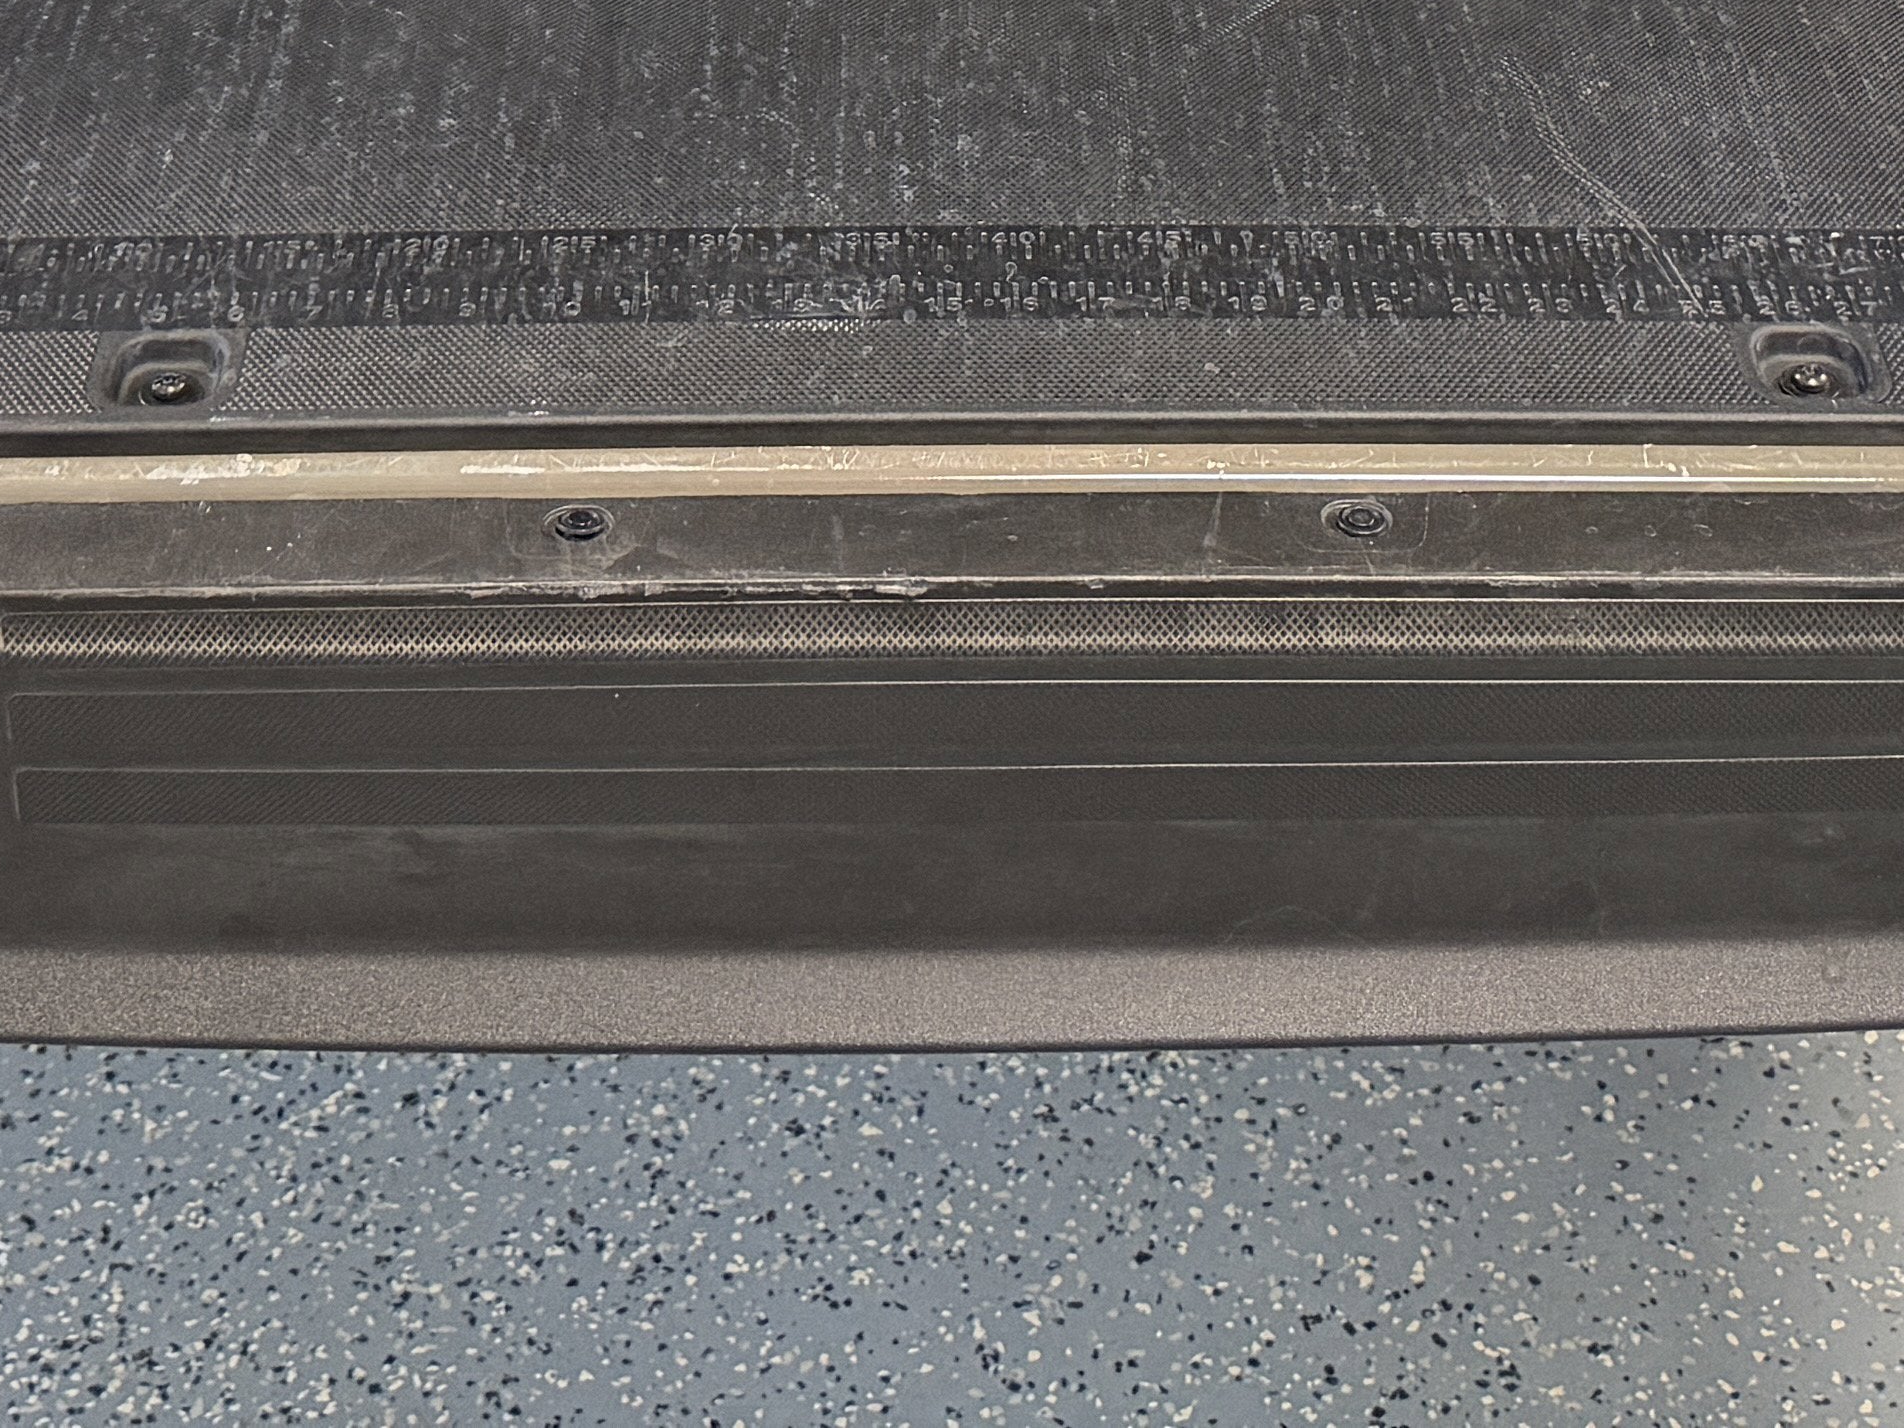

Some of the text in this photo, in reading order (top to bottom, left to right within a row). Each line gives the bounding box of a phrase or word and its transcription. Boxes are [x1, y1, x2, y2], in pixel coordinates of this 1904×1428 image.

[992, 231, 1036, 245] 40
[1137, 231, 1182, 244] 45
[1430, 232, 1475, 246] 55
[924, 297, 963, 312] 15
[1076, 297, 1116, 312] 17
[1298, 296, 1345, 312] 20
[1451, 297, 1497, 313] 22
